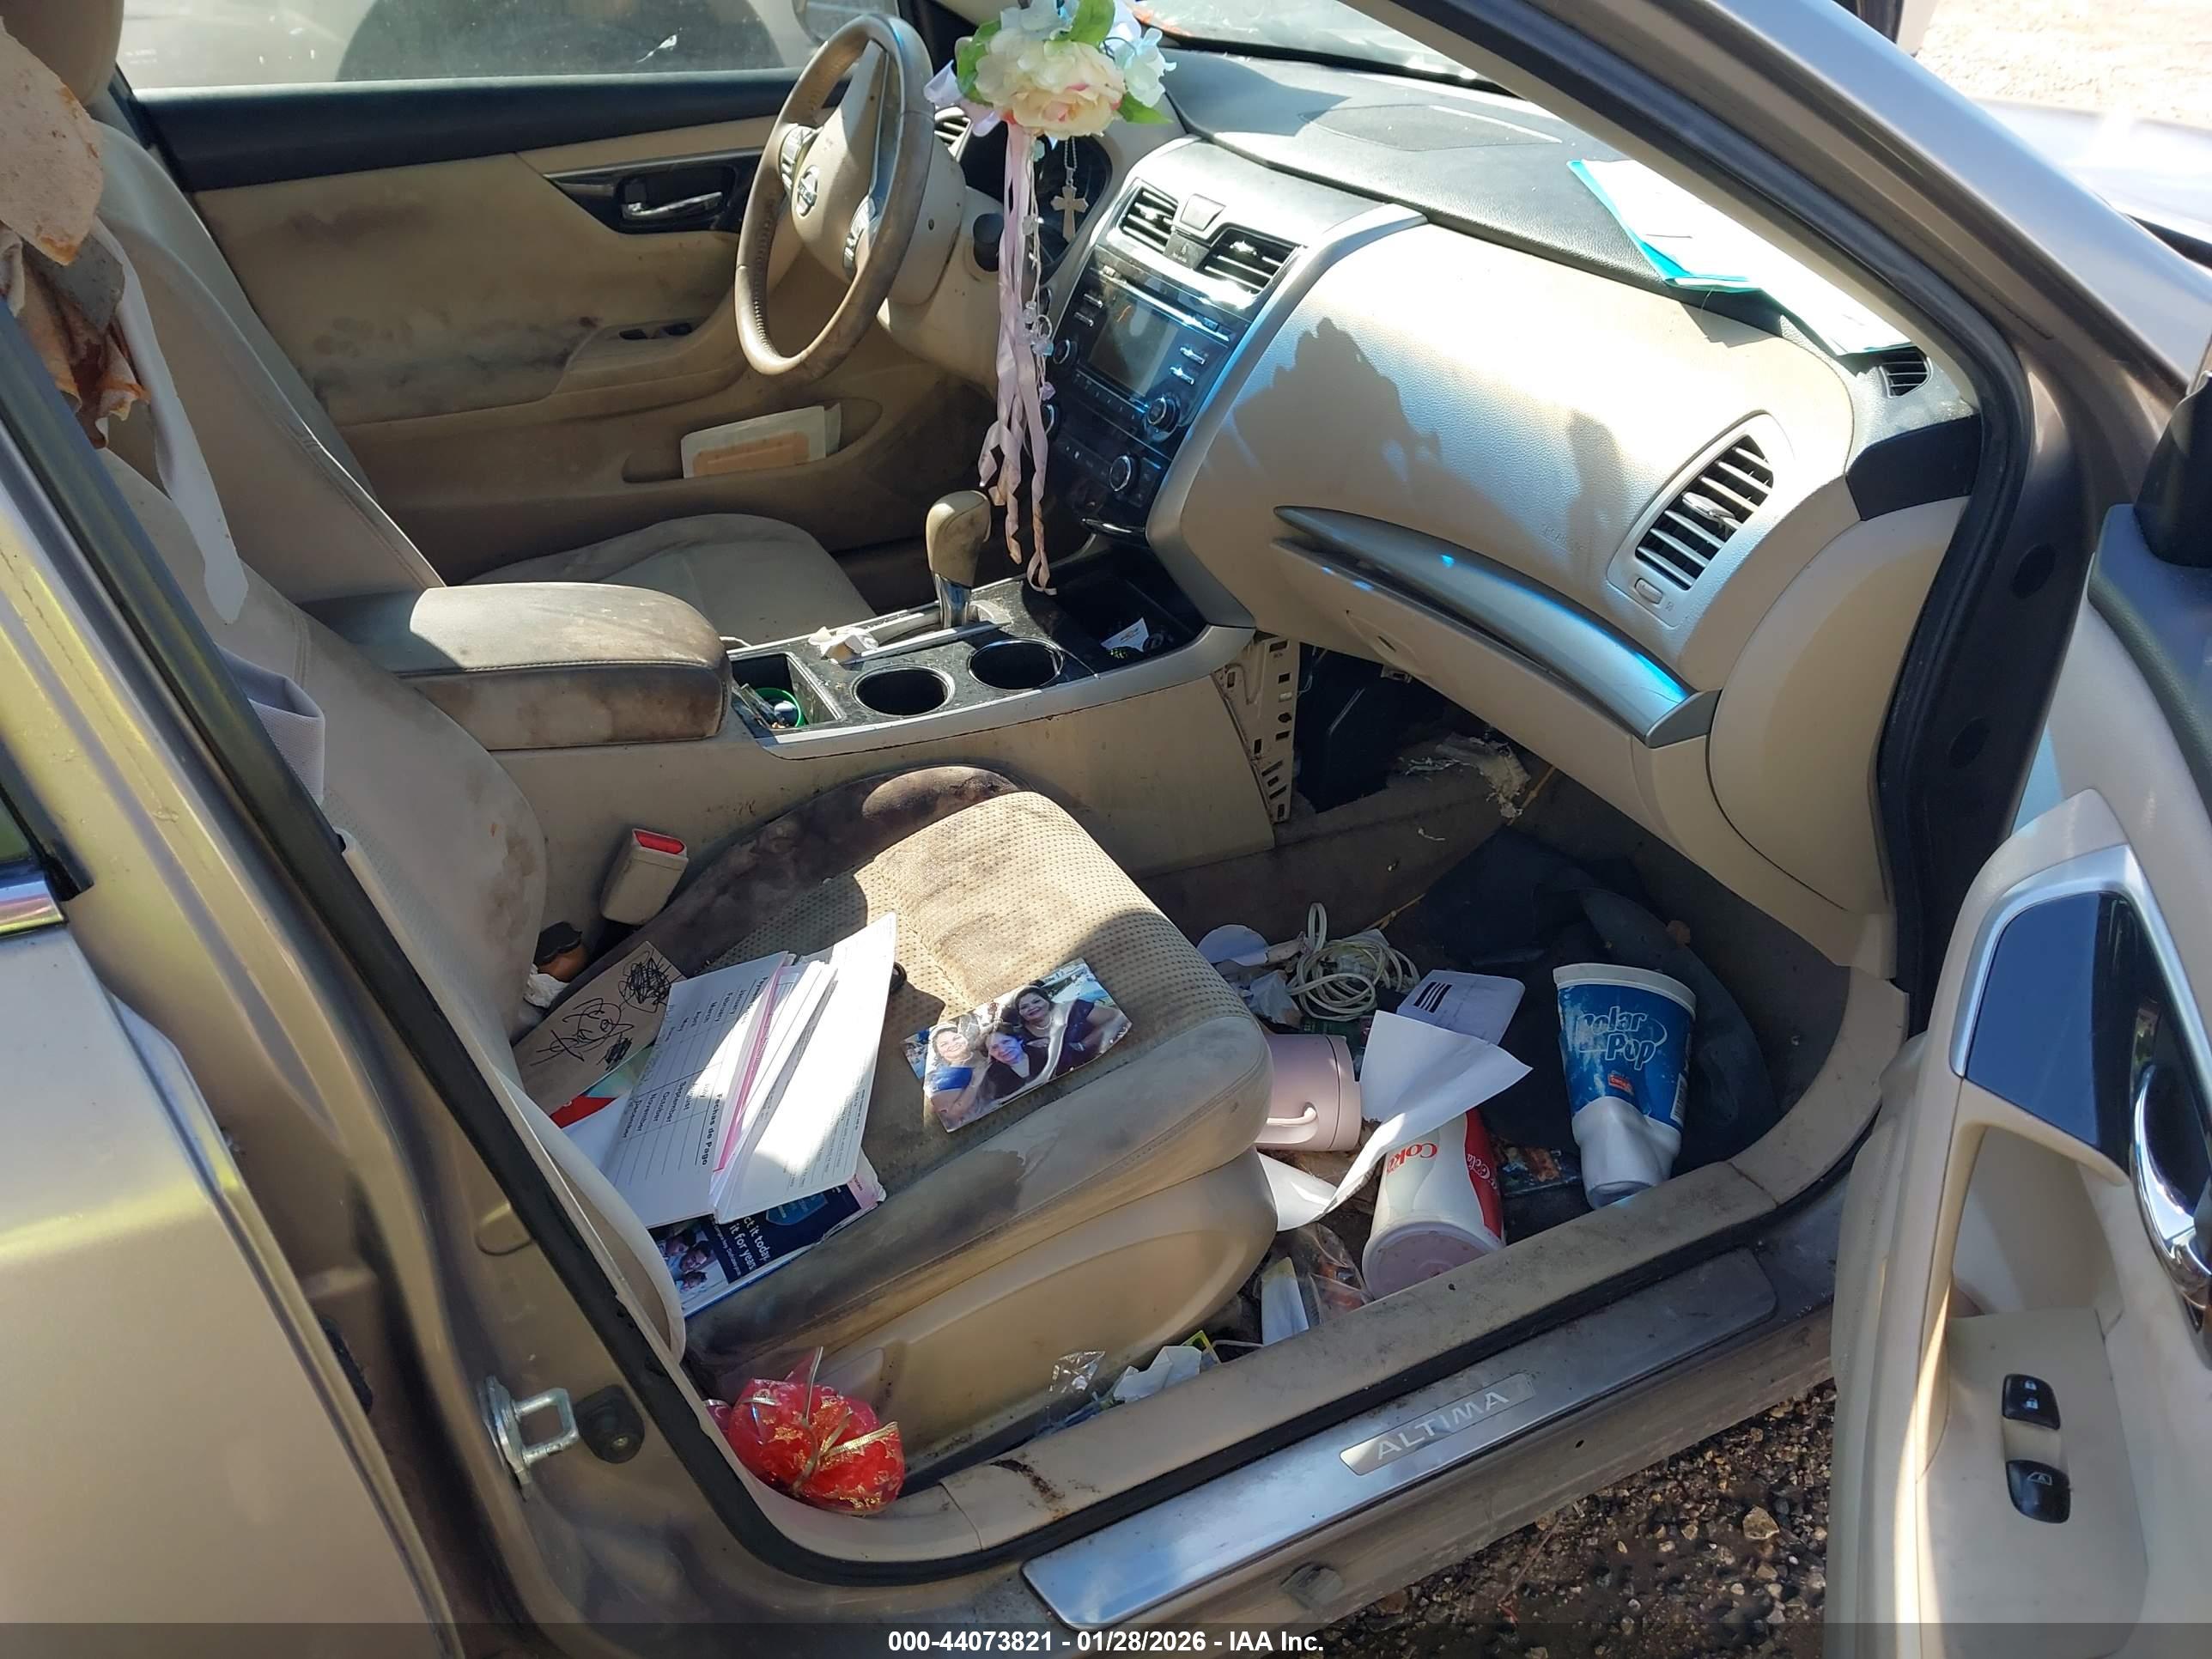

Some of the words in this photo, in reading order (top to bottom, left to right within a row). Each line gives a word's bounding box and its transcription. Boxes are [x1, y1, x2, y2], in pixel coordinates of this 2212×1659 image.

[703, 1001, 718, 1024] March
[714, 992, 733, 1022] February
[1605, 1033, 1656, 1071] Pop
[636, 1093, 658, 1132] November
[653, 1091, 671, 1121] October
[665, 1080, 687, 1123] September
[708, 1093, 724, 1127] Fechas
[706, 1127, 714, 1139] de
[701, 1141, 714, 1166] Pago
[1387, 1141, 1438, 1174] Coke
[729, 1223, 740, 1235] it
[734, 1232, 747, 1249] for
[749, 1225, 760, 1237] it
[1377, 1391, 1510, 1461] ALTIMA
